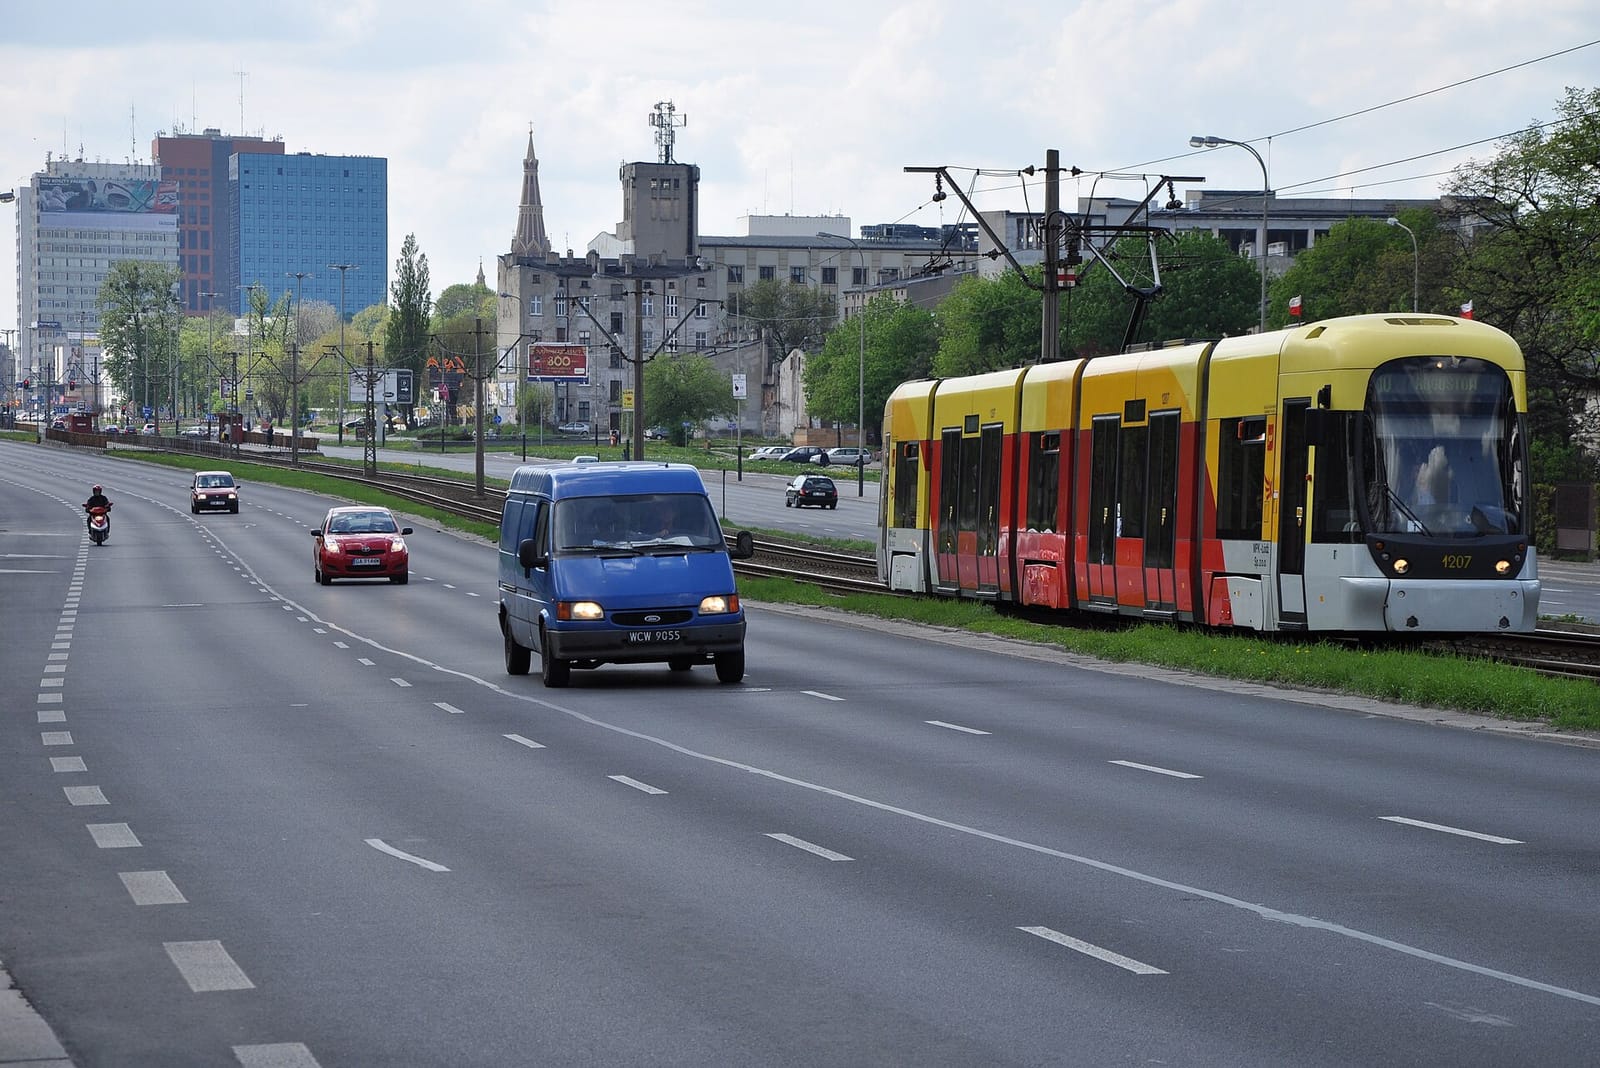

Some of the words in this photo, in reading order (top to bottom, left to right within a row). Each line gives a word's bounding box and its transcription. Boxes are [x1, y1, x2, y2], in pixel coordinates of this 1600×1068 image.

[1442, 554, 1473, 569] 1207
[629, 631, 652, 642] WCW
[655, 630, 681, 641] 9055
